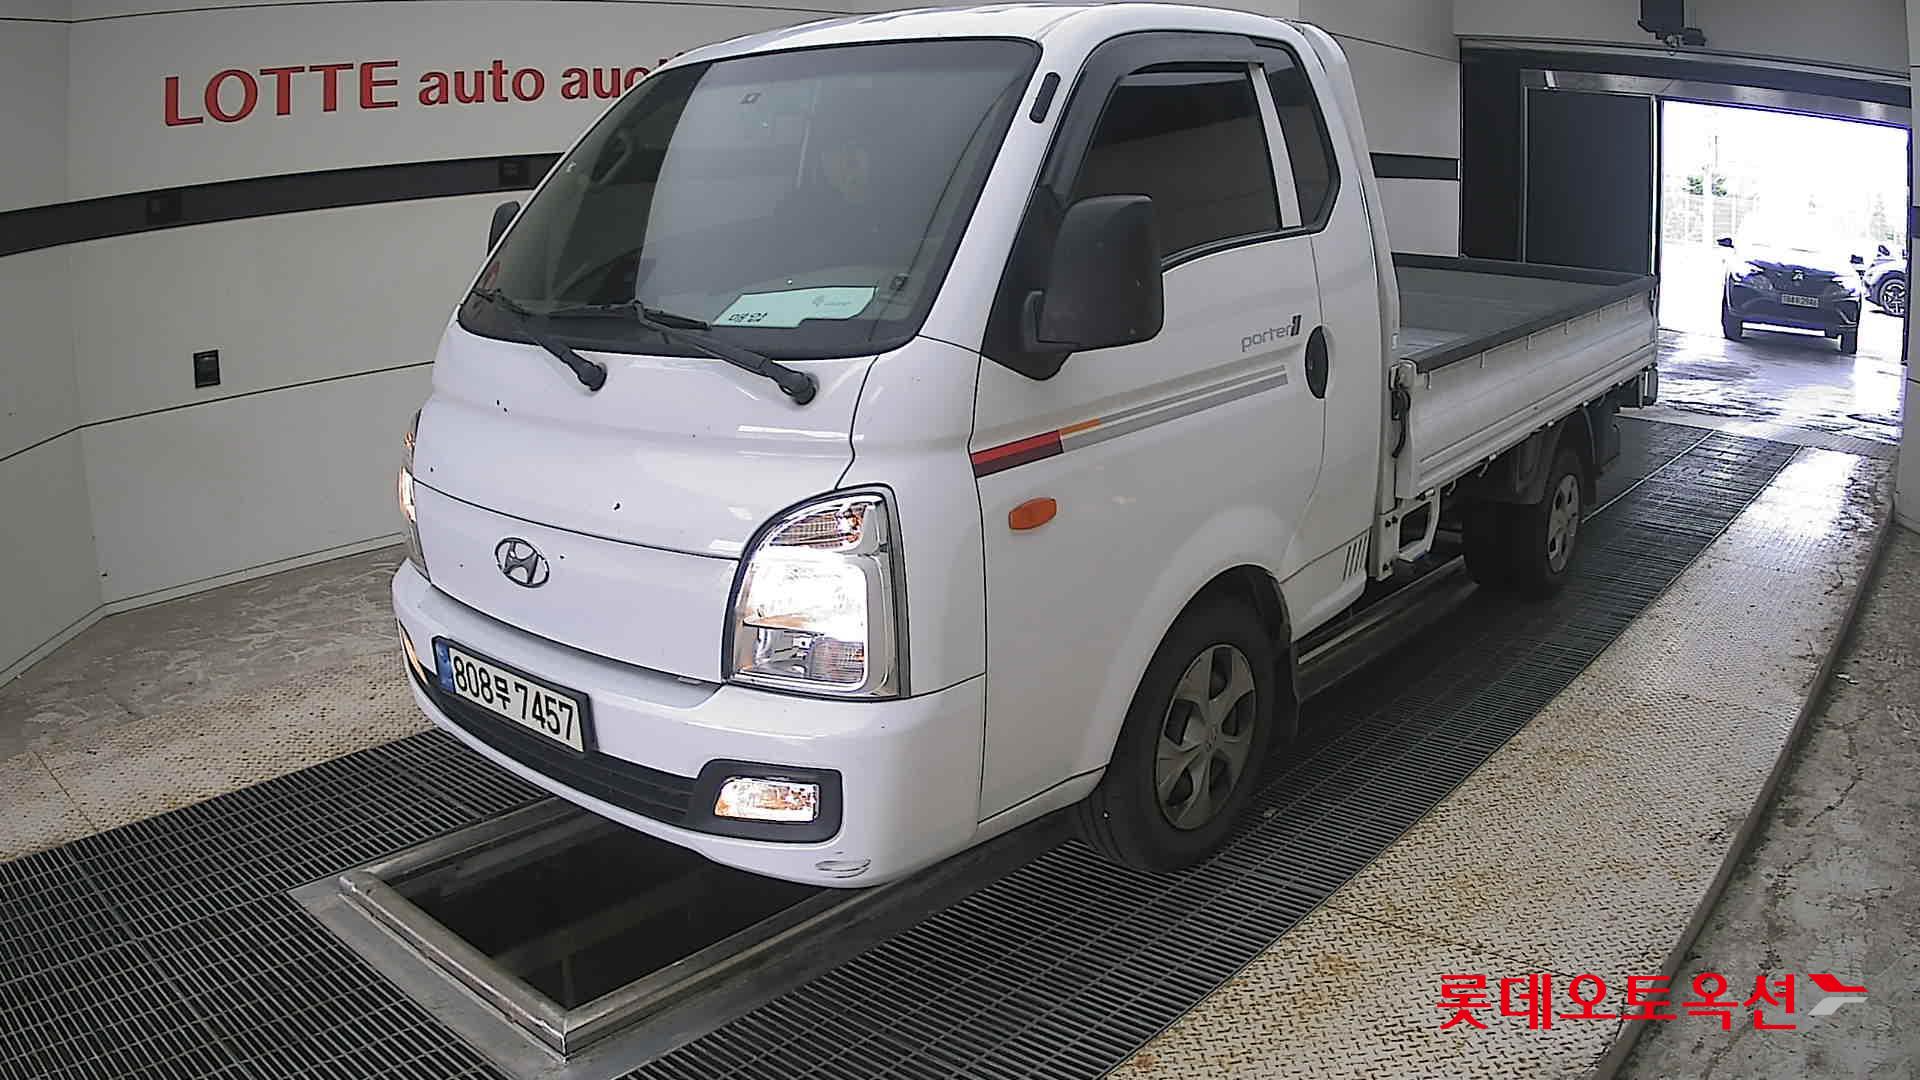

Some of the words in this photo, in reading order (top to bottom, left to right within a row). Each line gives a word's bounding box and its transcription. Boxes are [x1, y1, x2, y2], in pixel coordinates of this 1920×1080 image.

[164, 60, 399, 126] LOTTE
[418, 60, 545, 105] auto
[514, 681, 574, 741] 7457
